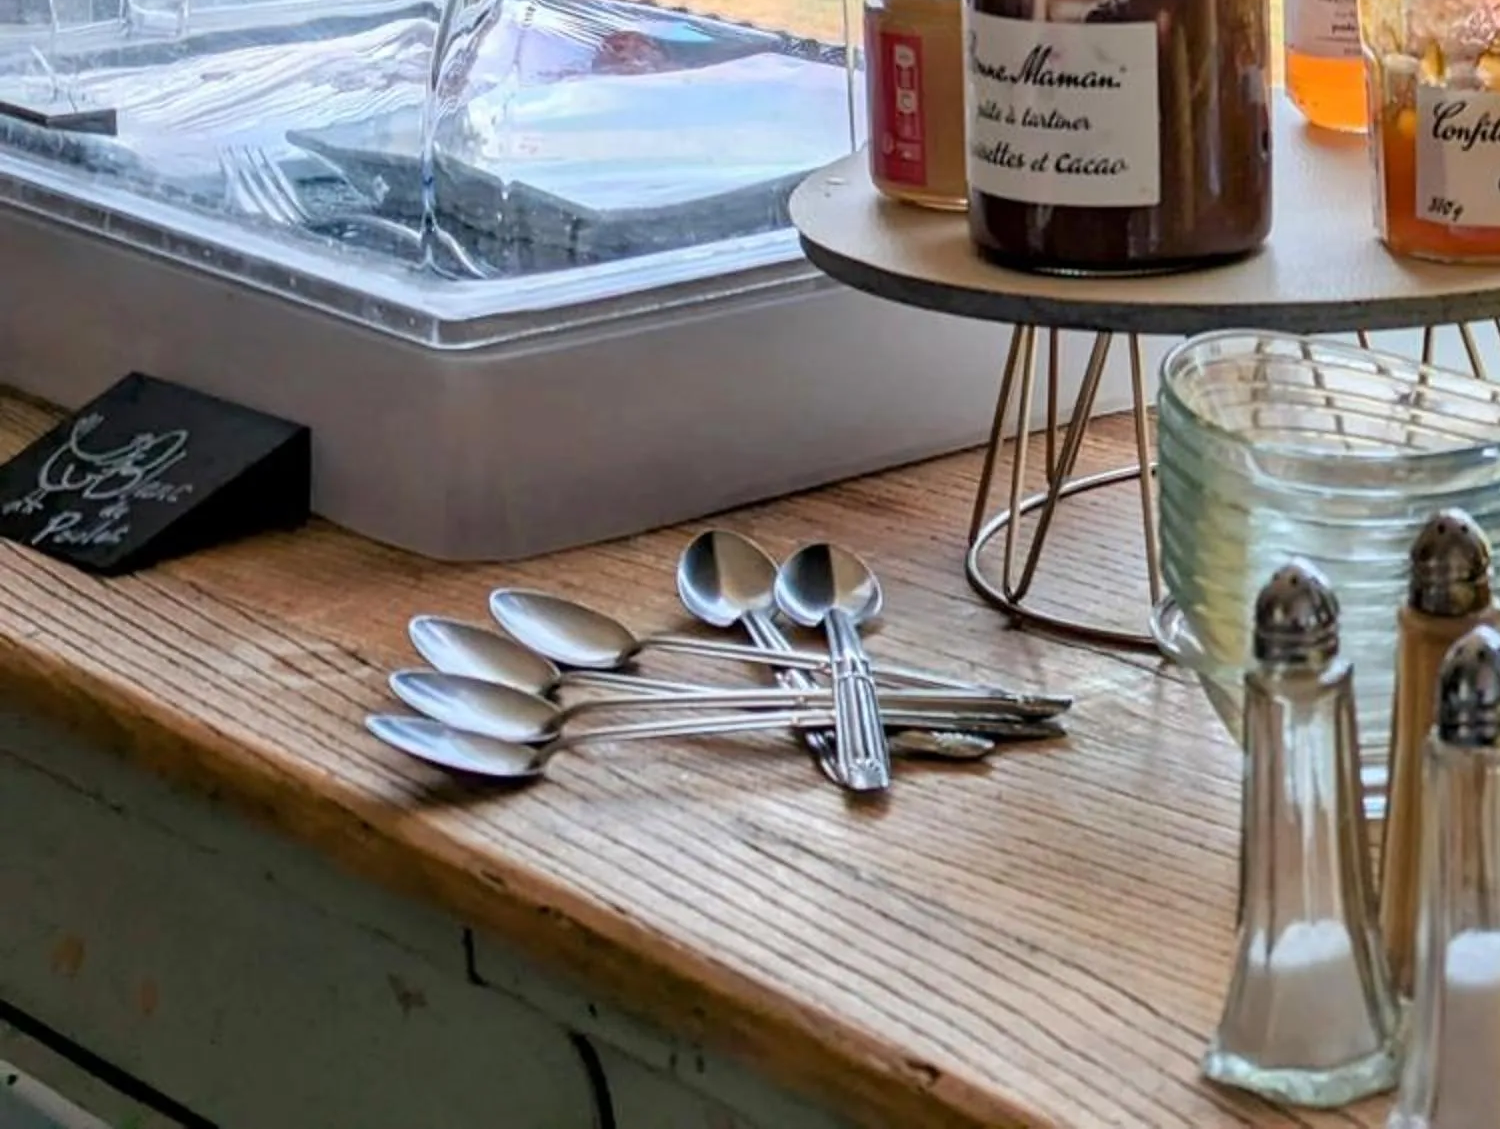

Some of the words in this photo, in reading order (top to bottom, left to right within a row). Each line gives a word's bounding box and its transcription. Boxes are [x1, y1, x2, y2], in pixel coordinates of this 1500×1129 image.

[1010, 45, 1122, 89] Maman
[1021, 106, 1093, 131] tartiner
[1054, 151, 1130, 176] Cacao
